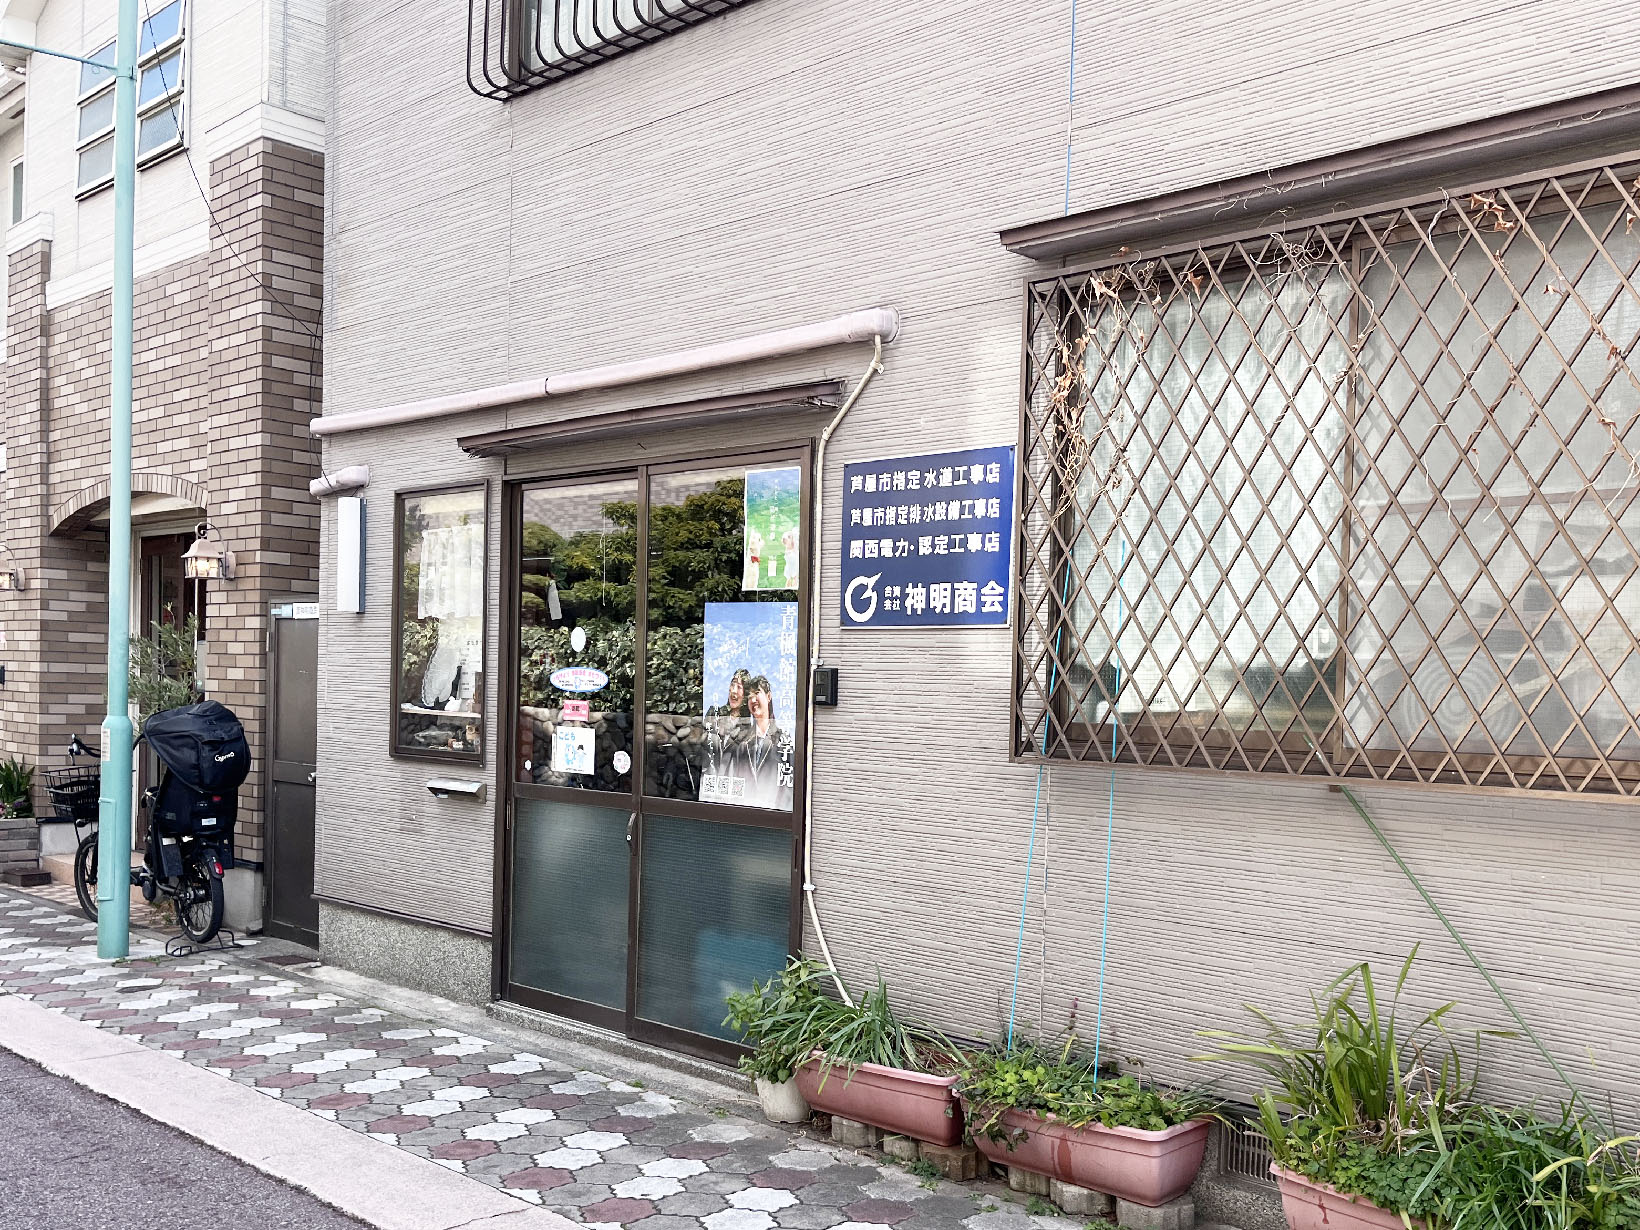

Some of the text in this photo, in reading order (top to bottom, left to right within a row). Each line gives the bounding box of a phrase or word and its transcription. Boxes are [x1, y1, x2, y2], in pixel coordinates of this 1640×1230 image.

[850, 462, 1001, 494] 芦屋市指定水道工事店
[850, 497, 1001, 527] 芦屋市指定排水設備工事店
[904, 580, 1005, 615] 神明商会
